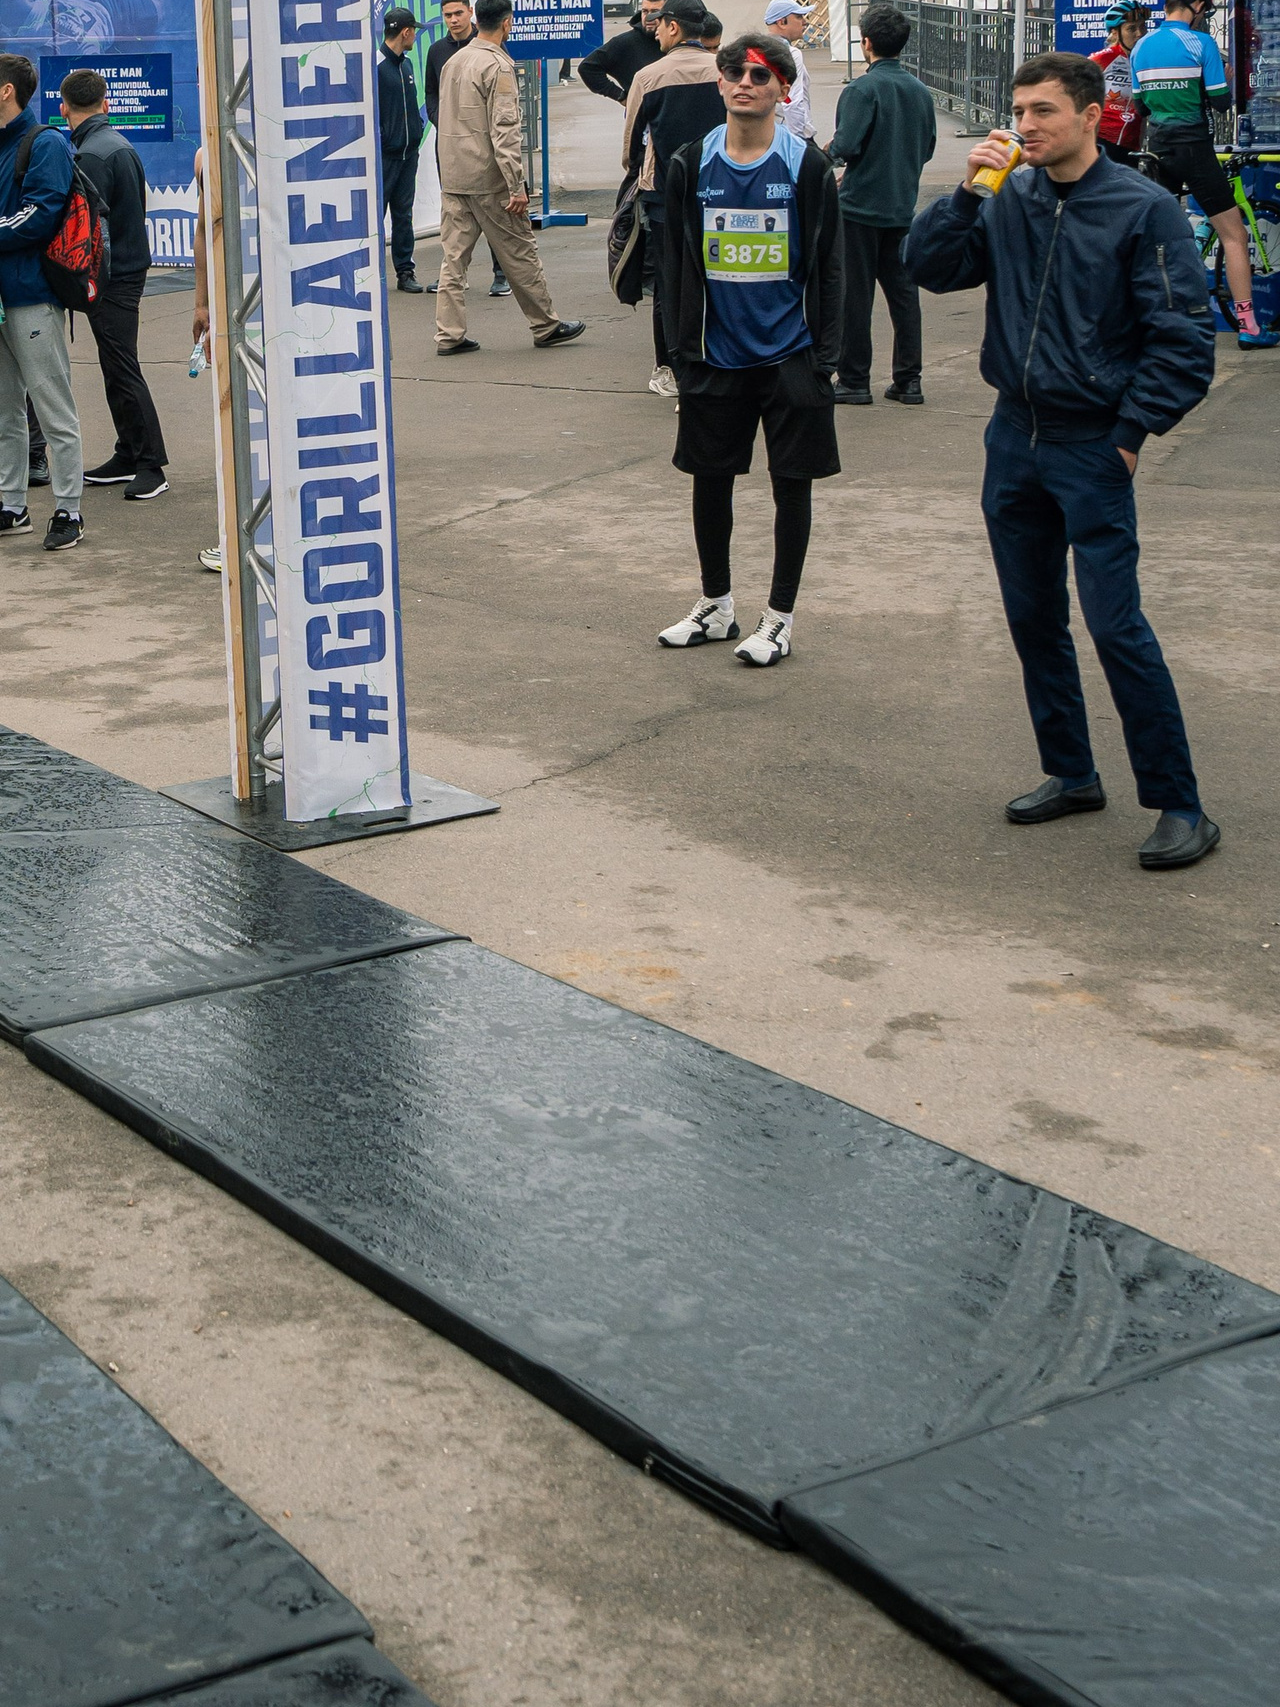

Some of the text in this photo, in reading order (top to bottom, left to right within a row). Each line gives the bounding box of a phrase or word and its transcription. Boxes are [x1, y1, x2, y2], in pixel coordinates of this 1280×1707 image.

[524, 15, 553, 25] ENERGY
[1072, 12, 1105, 22] ТЕРРИТОР
[549, 31, 581, 40] MUMKIN
[1090, 30, 1109, 39] SLOW
[120, 67, 143, 78] MAN
[110, 81, 151, 90] INDIVIDUAL
[709, 243, 783, 264] C 3875
